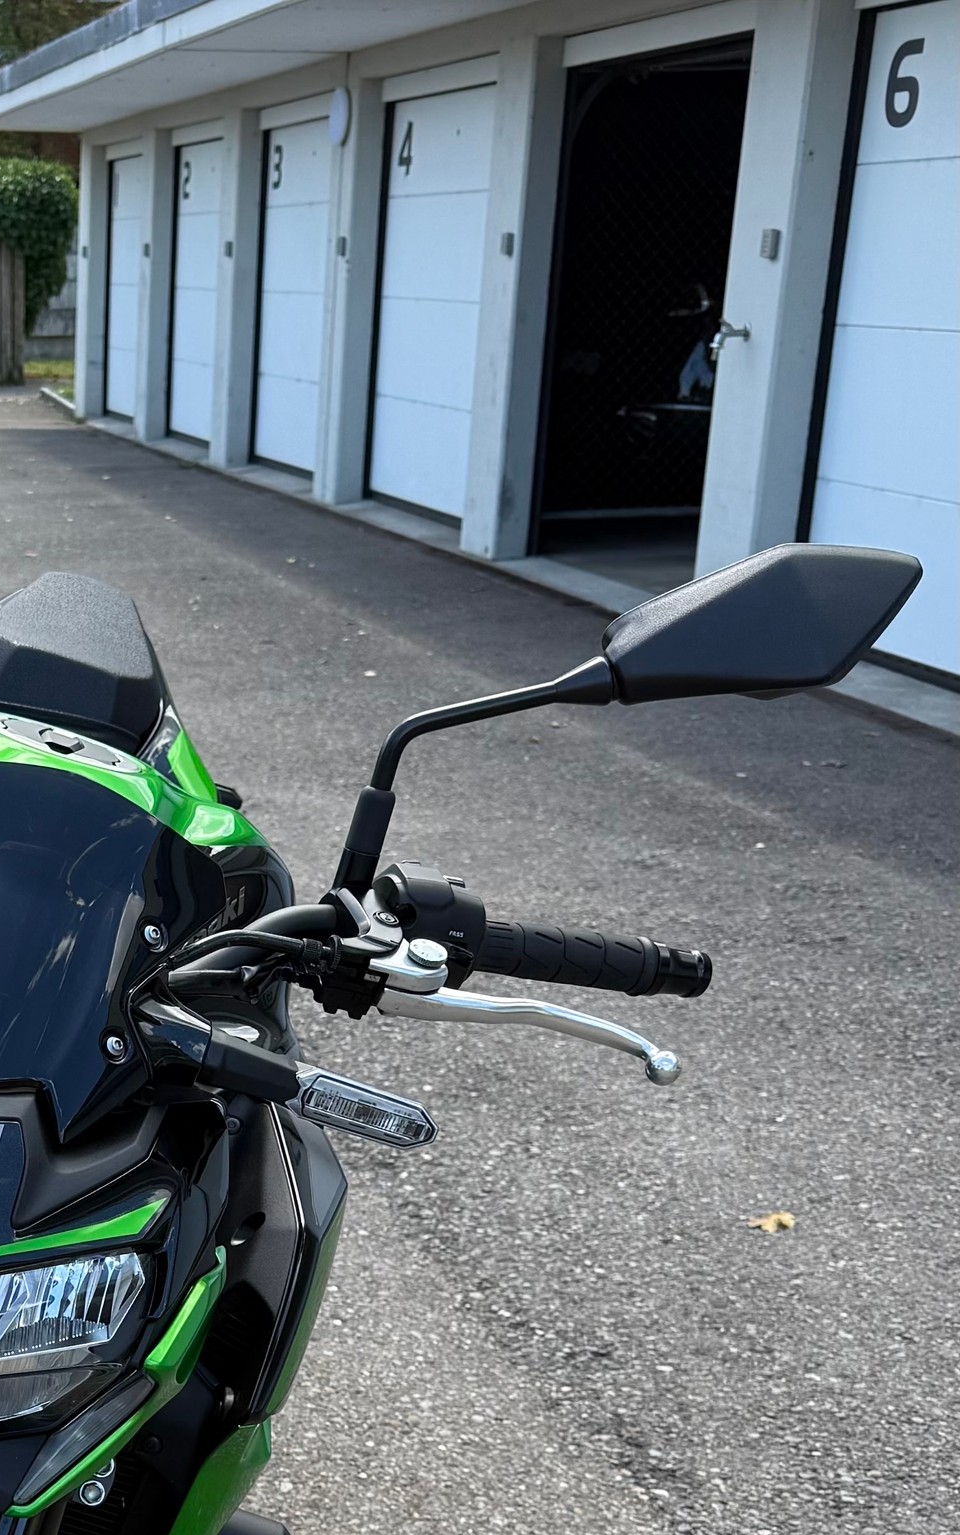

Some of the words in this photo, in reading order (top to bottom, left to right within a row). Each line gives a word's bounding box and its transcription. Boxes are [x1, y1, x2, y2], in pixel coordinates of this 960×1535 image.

[885, 37, 925, 128] 6
[272, 144, 283, 190] 3
[398, 120, 413, 177] 4
[182, 161, 191, 199] 2
